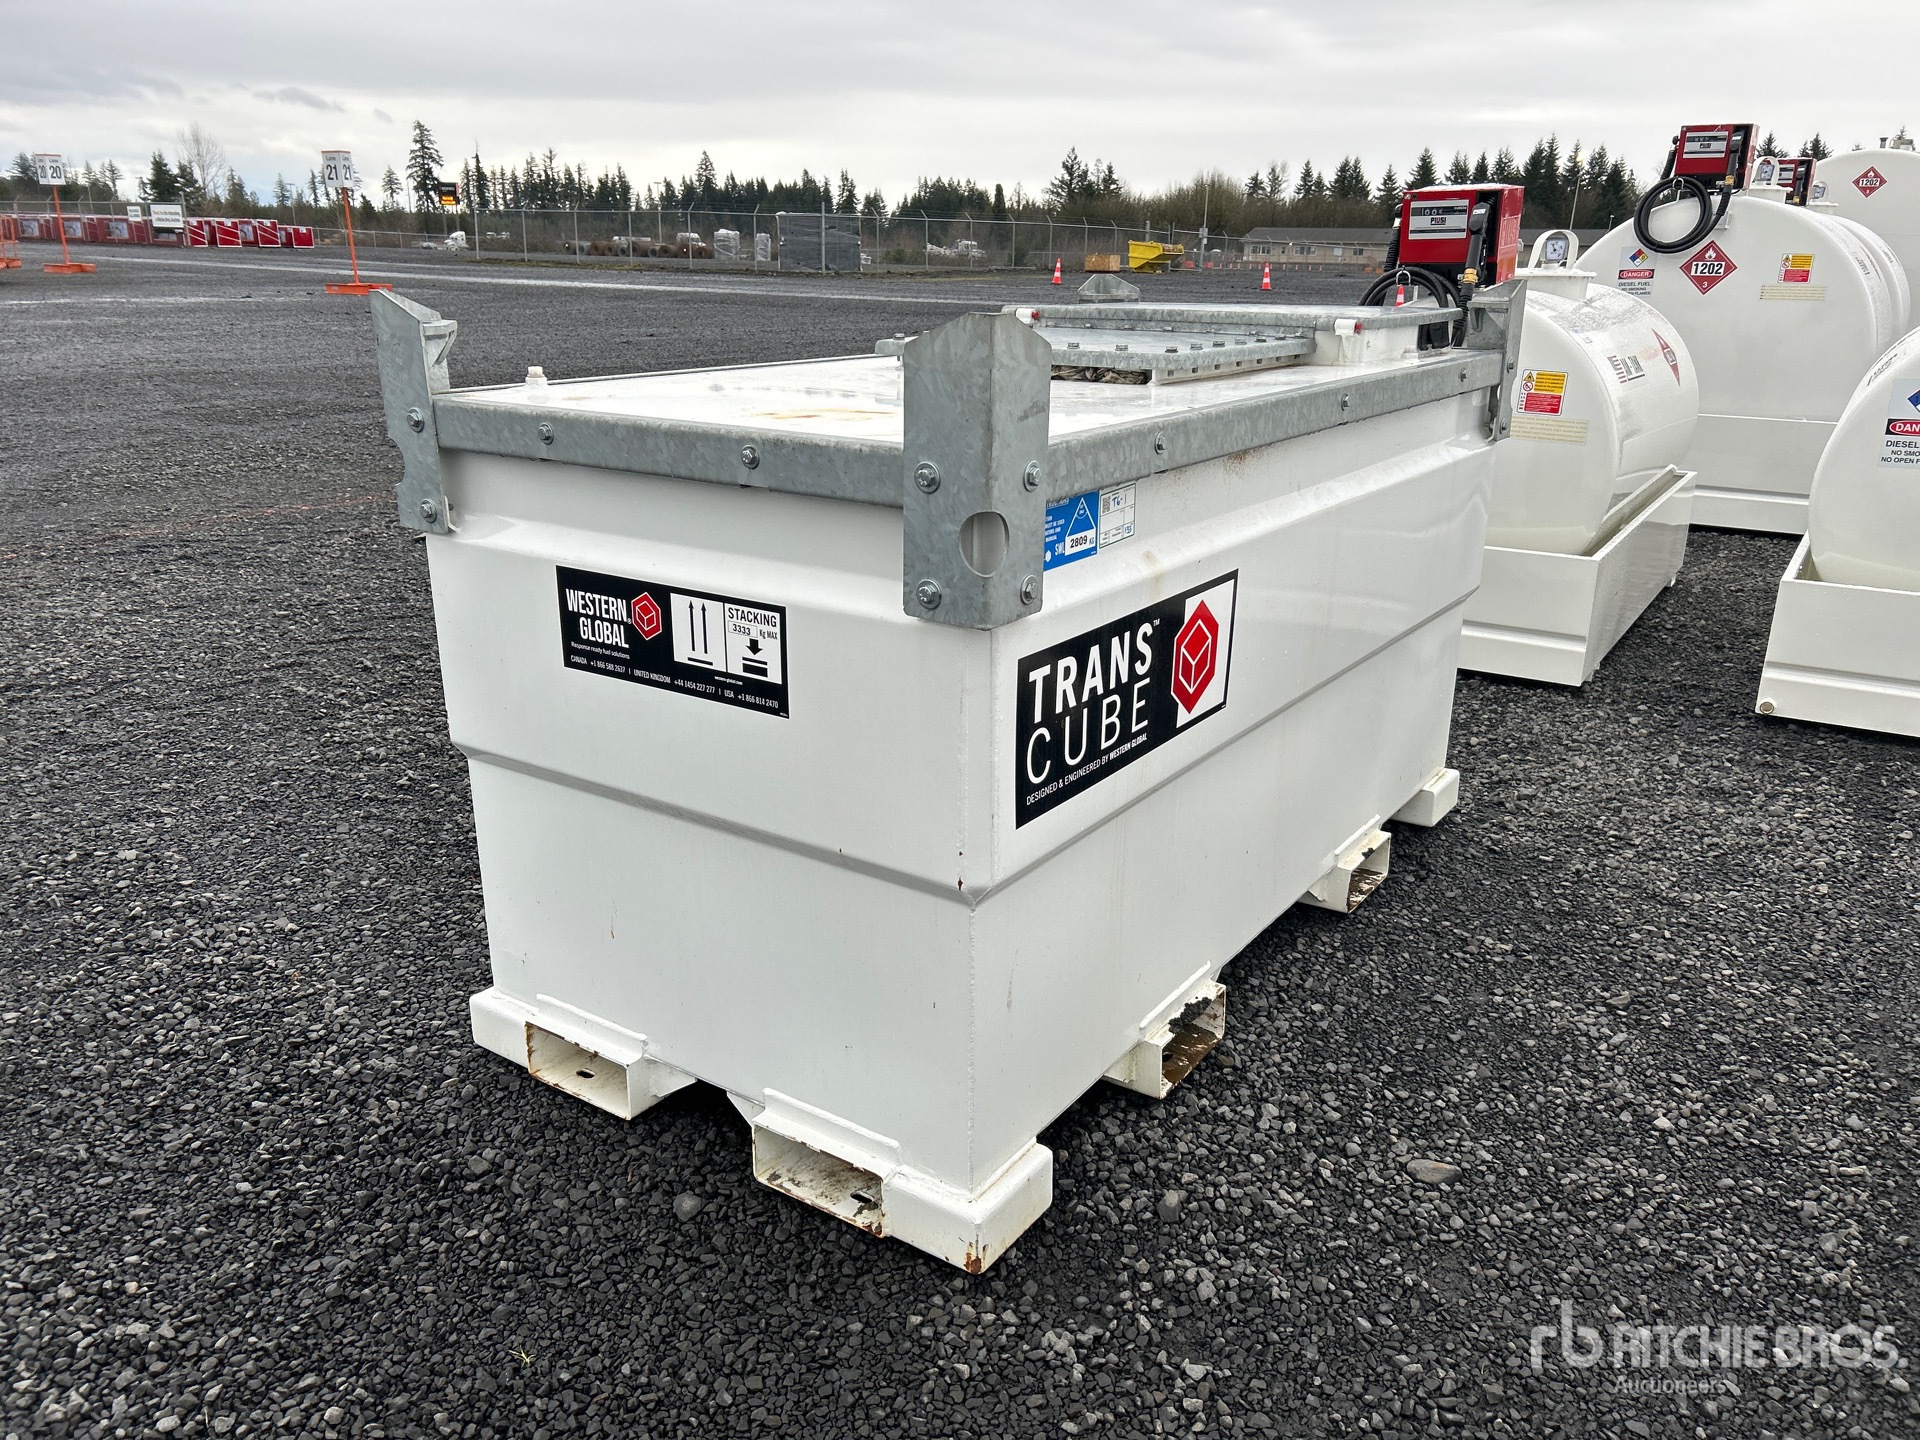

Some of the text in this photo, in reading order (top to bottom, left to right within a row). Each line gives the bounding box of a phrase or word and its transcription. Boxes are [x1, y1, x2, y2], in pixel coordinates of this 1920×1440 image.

[49, 165, 62, 179] 20
[326, 164, 338, 180] 21
[343, 164, 352, 180] 21
[1430, 217, 1446, 225] PIUSI
[1693, 262, 1723, 275] 1202
[1895, 423, 1920, 432] DAN
[1885, 440, 1919, 448] DIESEL
[1070, 535, 1088, 549] 2809
[565, 588, 628, 623] WESTERN
[728, 607, 777, 628] STACKING
[579, 616, 629, 649] GLOBAL
[732, 623, 751, 636] 3333
[766, 630, 778, 640] MAX
[571, 641, 590, 651] Response
[571, 655, 588, 665] CANADA
[633, 669, 649, 679] UNITED
[650, 672, 671, 684] KINGDOM
[696, 683, 706, 692] 227
[706, 684, 716, 694] 277
[724, 689, 735, 698] USA
[737, 693, 745, 701] +1
[755, 696, 765, 705] 814
[765, 699, 779, 709] 2470
[1026, 677, 1150, 784] CUBE
[1026, 732, 1148, 806] DESIGNED & ENGINEERED BY WESTERN GLOBAL
